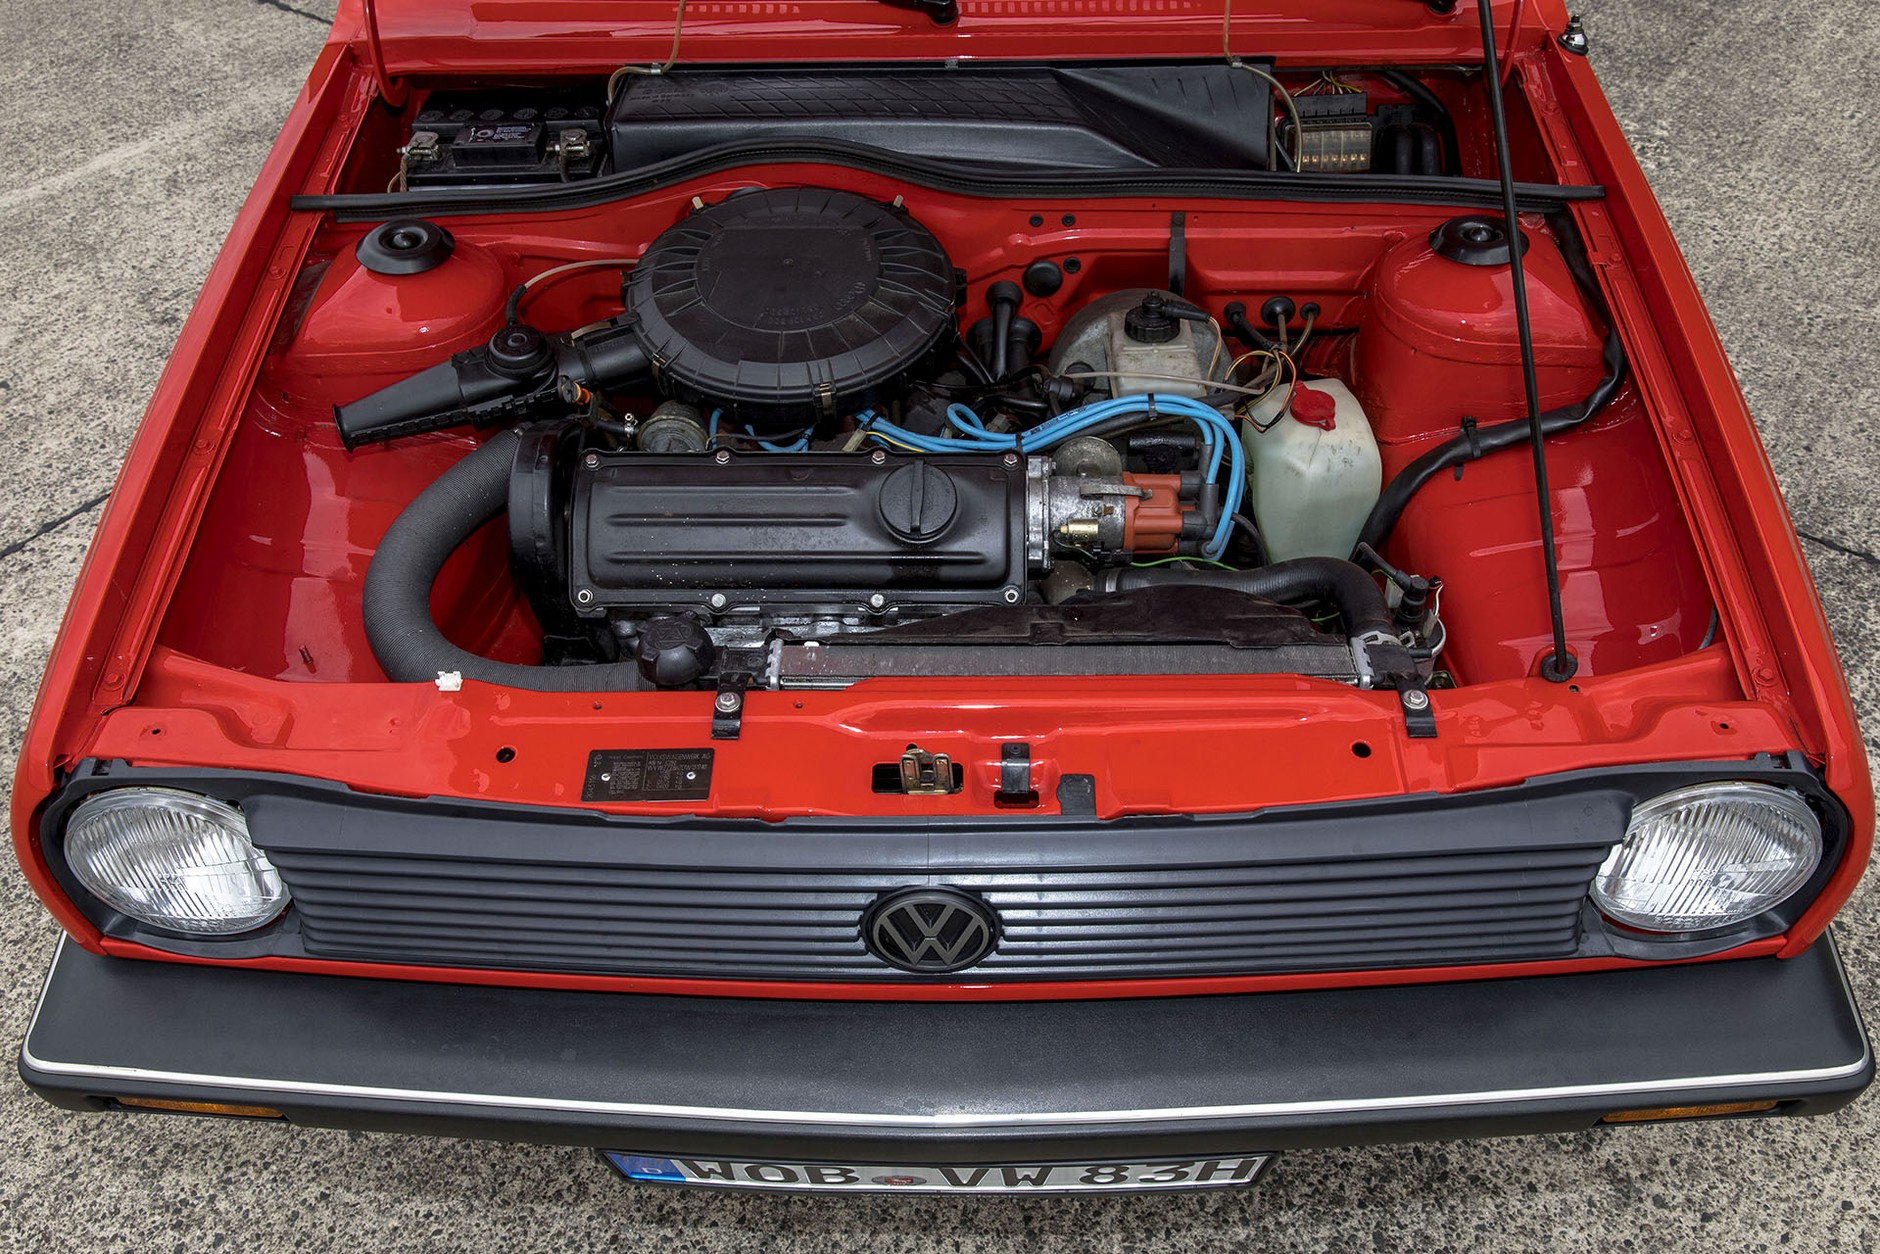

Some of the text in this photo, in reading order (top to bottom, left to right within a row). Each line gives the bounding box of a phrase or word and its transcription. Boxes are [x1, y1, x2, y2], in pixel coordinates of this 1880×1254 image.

[875, 900, 987, 969] VW
[678, 1158, 1258, 1187] WOB VW 83H
